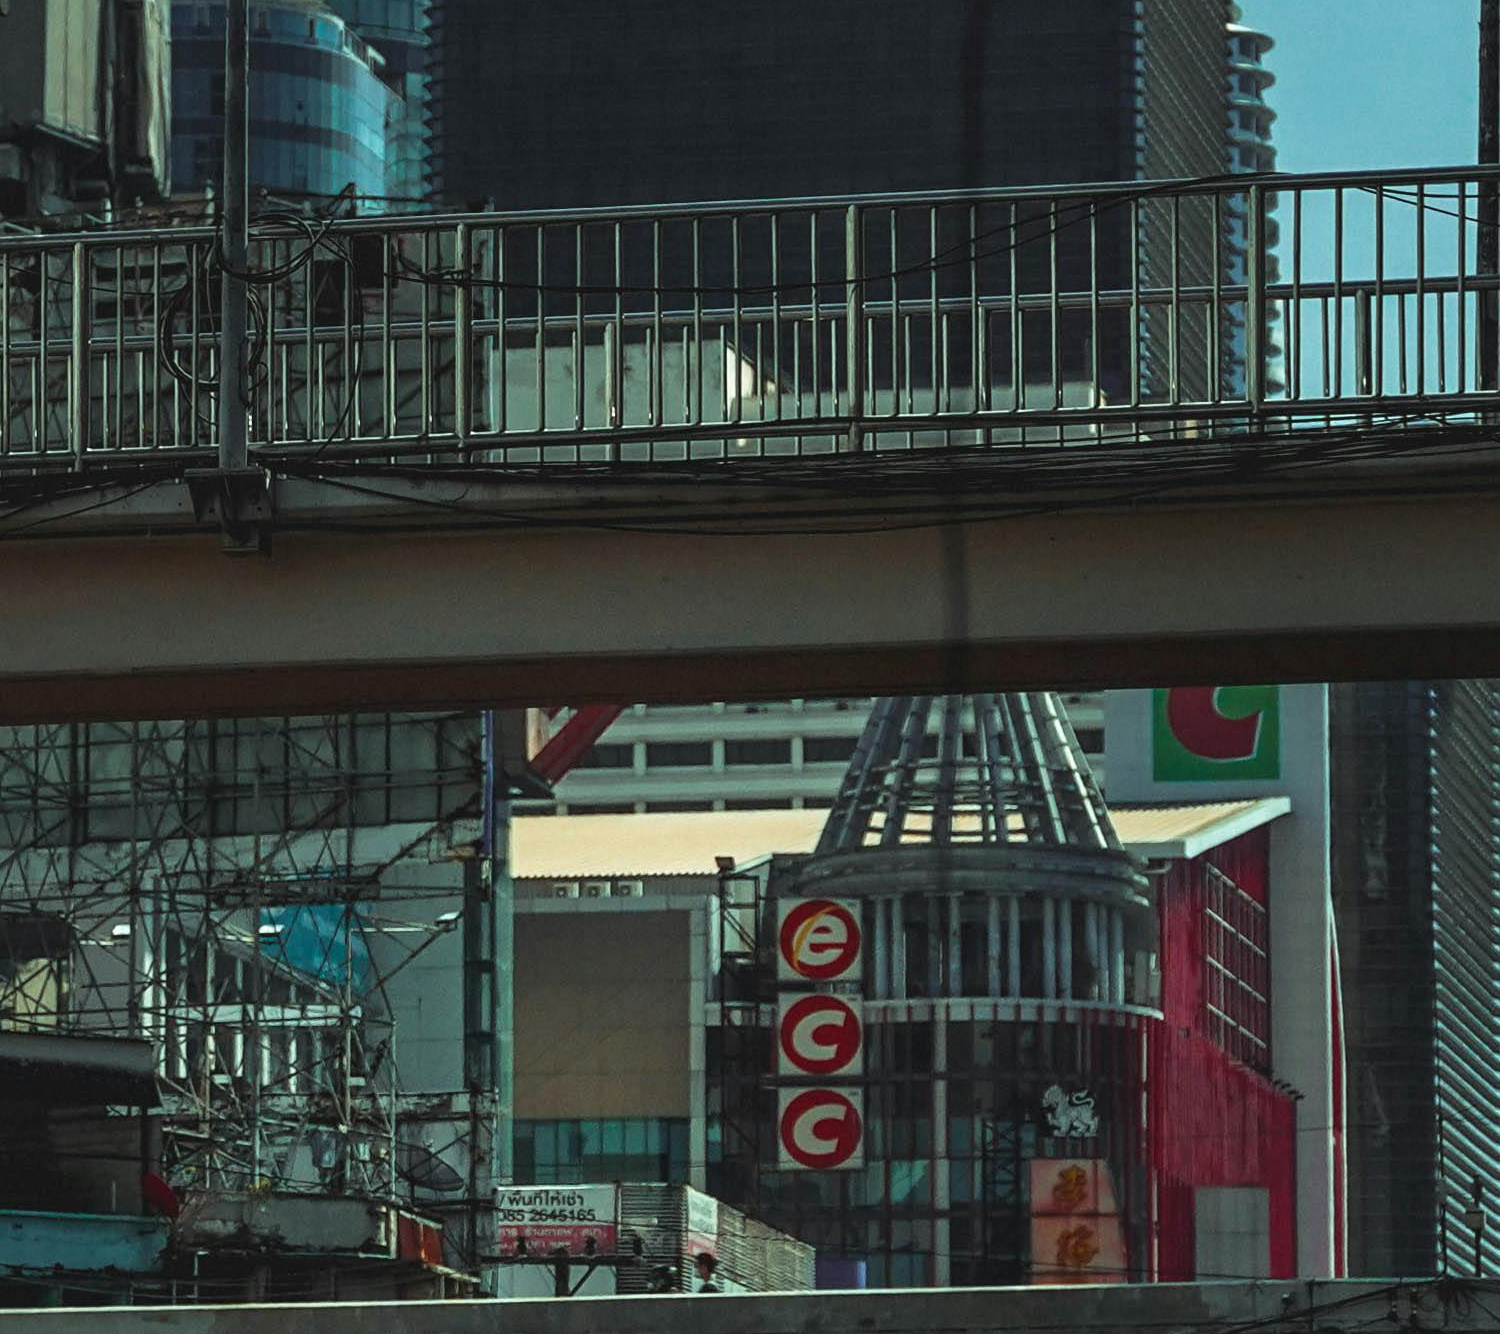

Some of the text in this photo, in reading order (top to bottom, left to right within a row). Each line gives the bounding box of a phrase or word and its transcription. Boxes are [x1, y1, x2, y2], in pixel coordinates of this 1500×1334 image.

[508, 1189, 585, 1207] พื้นที่ให้เช่า
